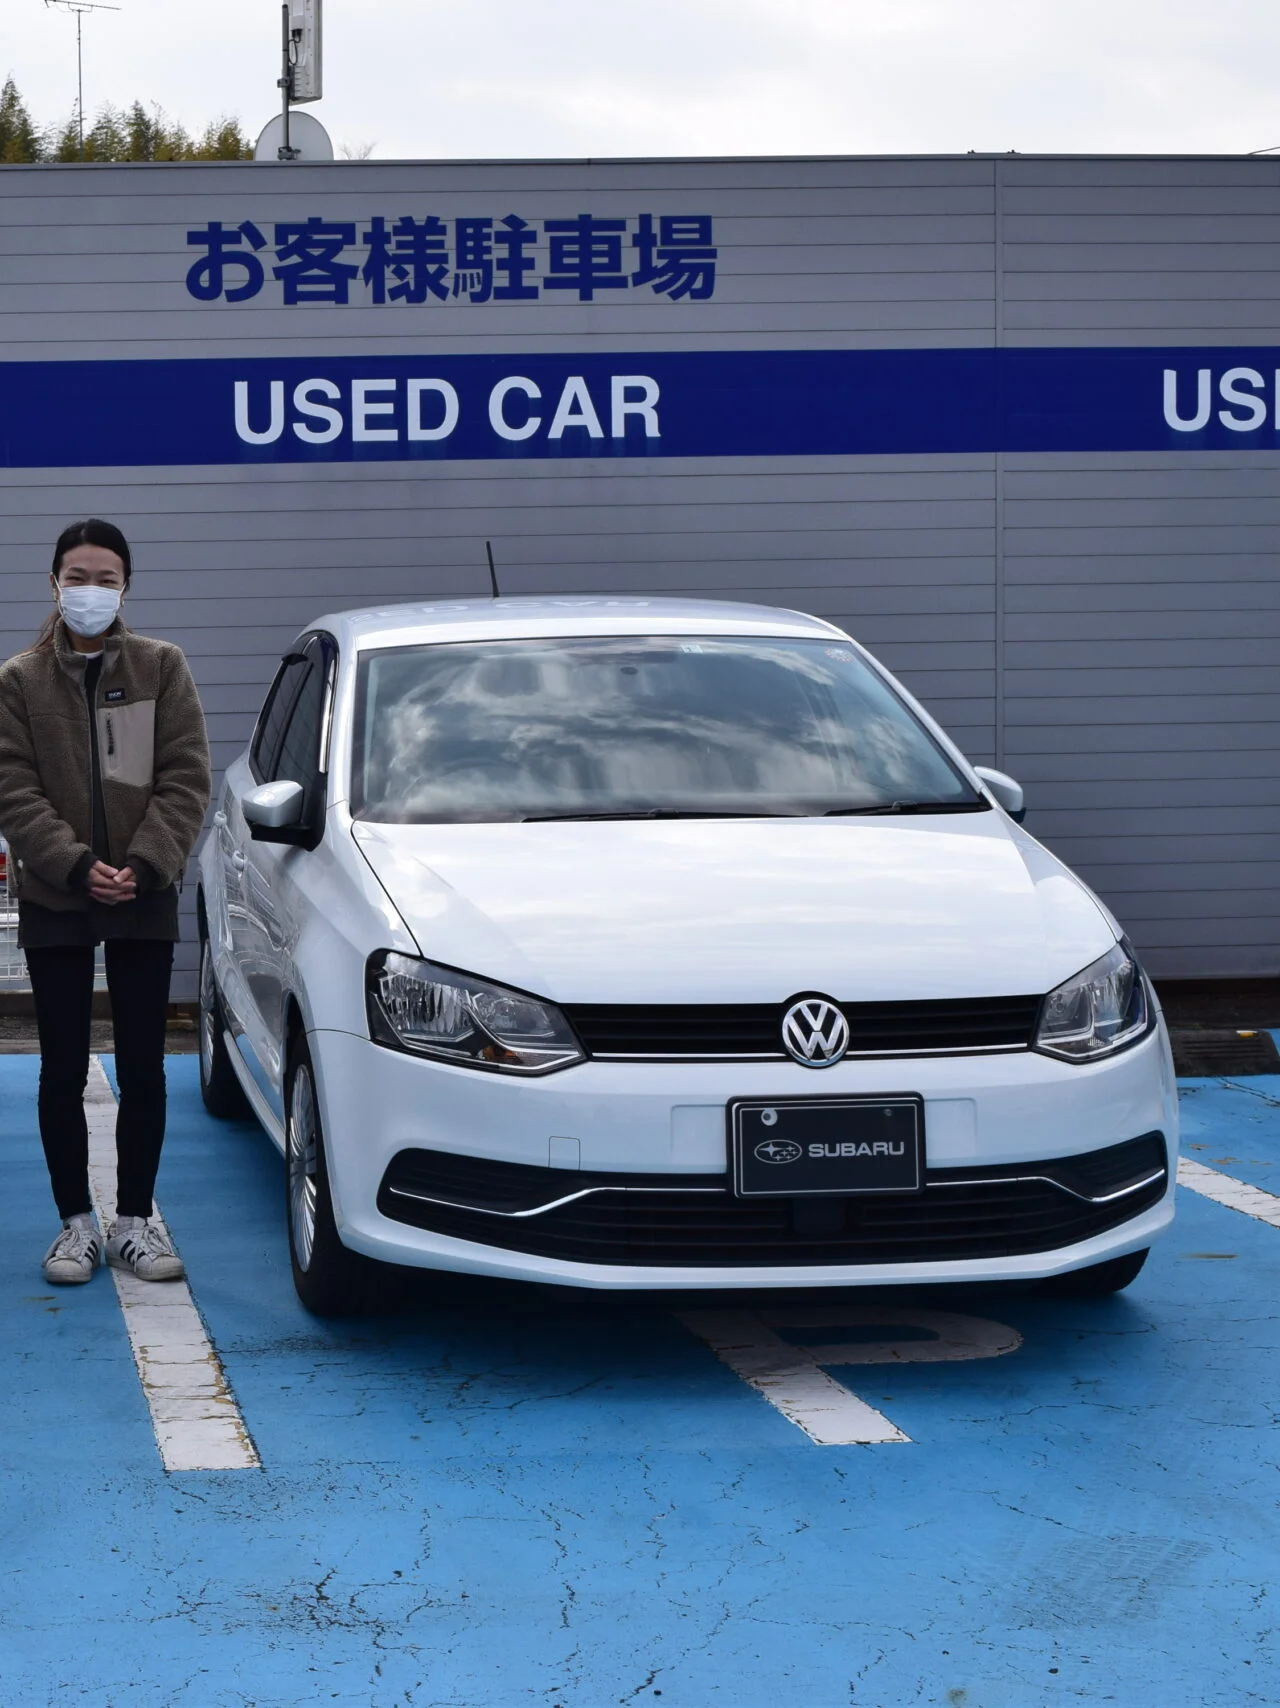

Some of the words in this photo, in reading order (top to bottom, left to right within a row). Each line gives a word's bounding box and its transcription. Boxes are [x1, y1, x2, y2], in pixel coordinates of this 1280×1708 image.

[185, 213, 718, 306] お客様駐車場
[234, 378, 460, 445] USED
[488, 375, 661, 441] CAR
[1163, 366, 1280, 432] US
[807, 1141, 905, 1158] SUBARU
